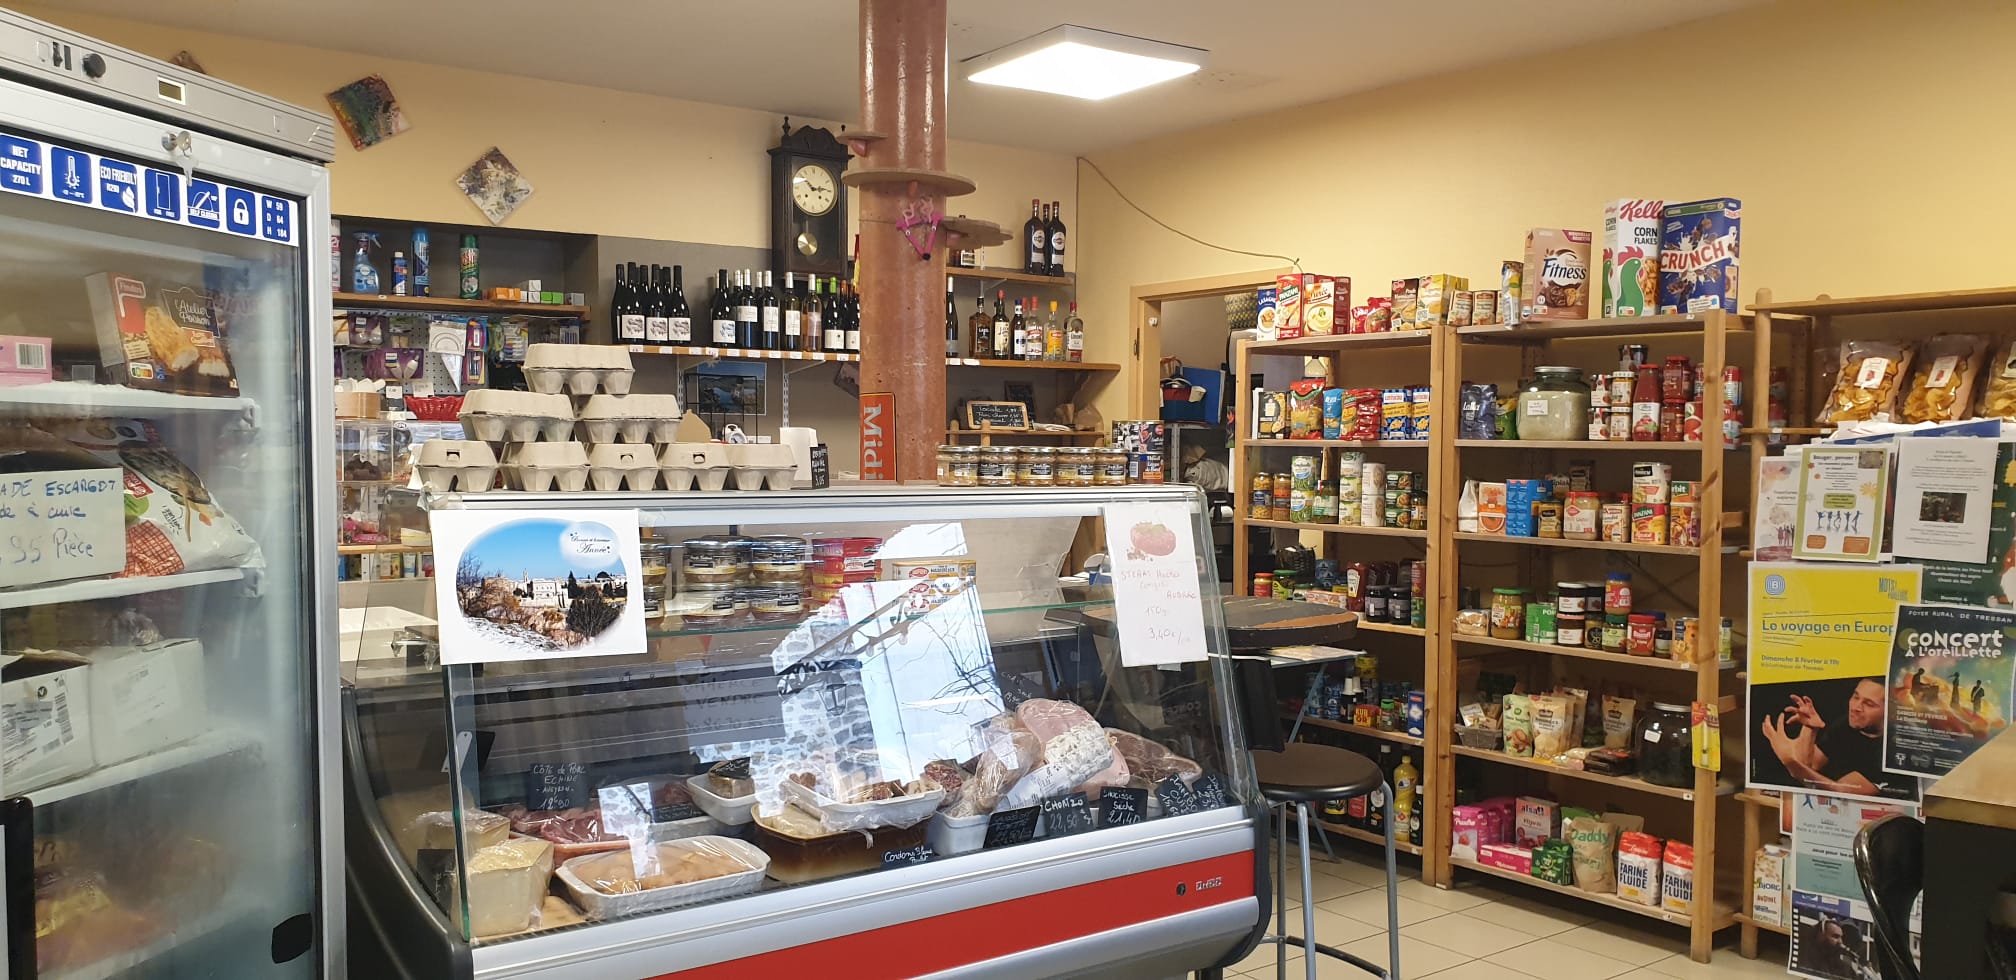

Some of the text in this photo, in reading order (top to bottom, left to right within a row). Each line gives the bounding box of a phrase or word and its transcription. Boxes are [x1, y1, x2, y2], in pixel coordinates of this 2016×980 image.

[12, 145, 29, 159] NET
[0, 157, 42, 175] CAPACITY
[100, 166, 137, 185] ECO FRIENDLY
[266, 200, 273, 209] W
[266, 226, 273, 235] H
[1633, 226, 1658, 237] CORN
[1634, 237, 1658, 245] FLAKES
[1660, 241, 1725, 270] CRUNCH
[1541, 257, 1587, 280] Fitness
[863, 403, 883, 480] Midi
[53, 527, 94, 559] Pièce
[1762, 619, 1894, 636] Le voyage en Europ
[1620, 863, 1649, 880] FARINE
[1619, 874, 1648, 889] FLUIDE
